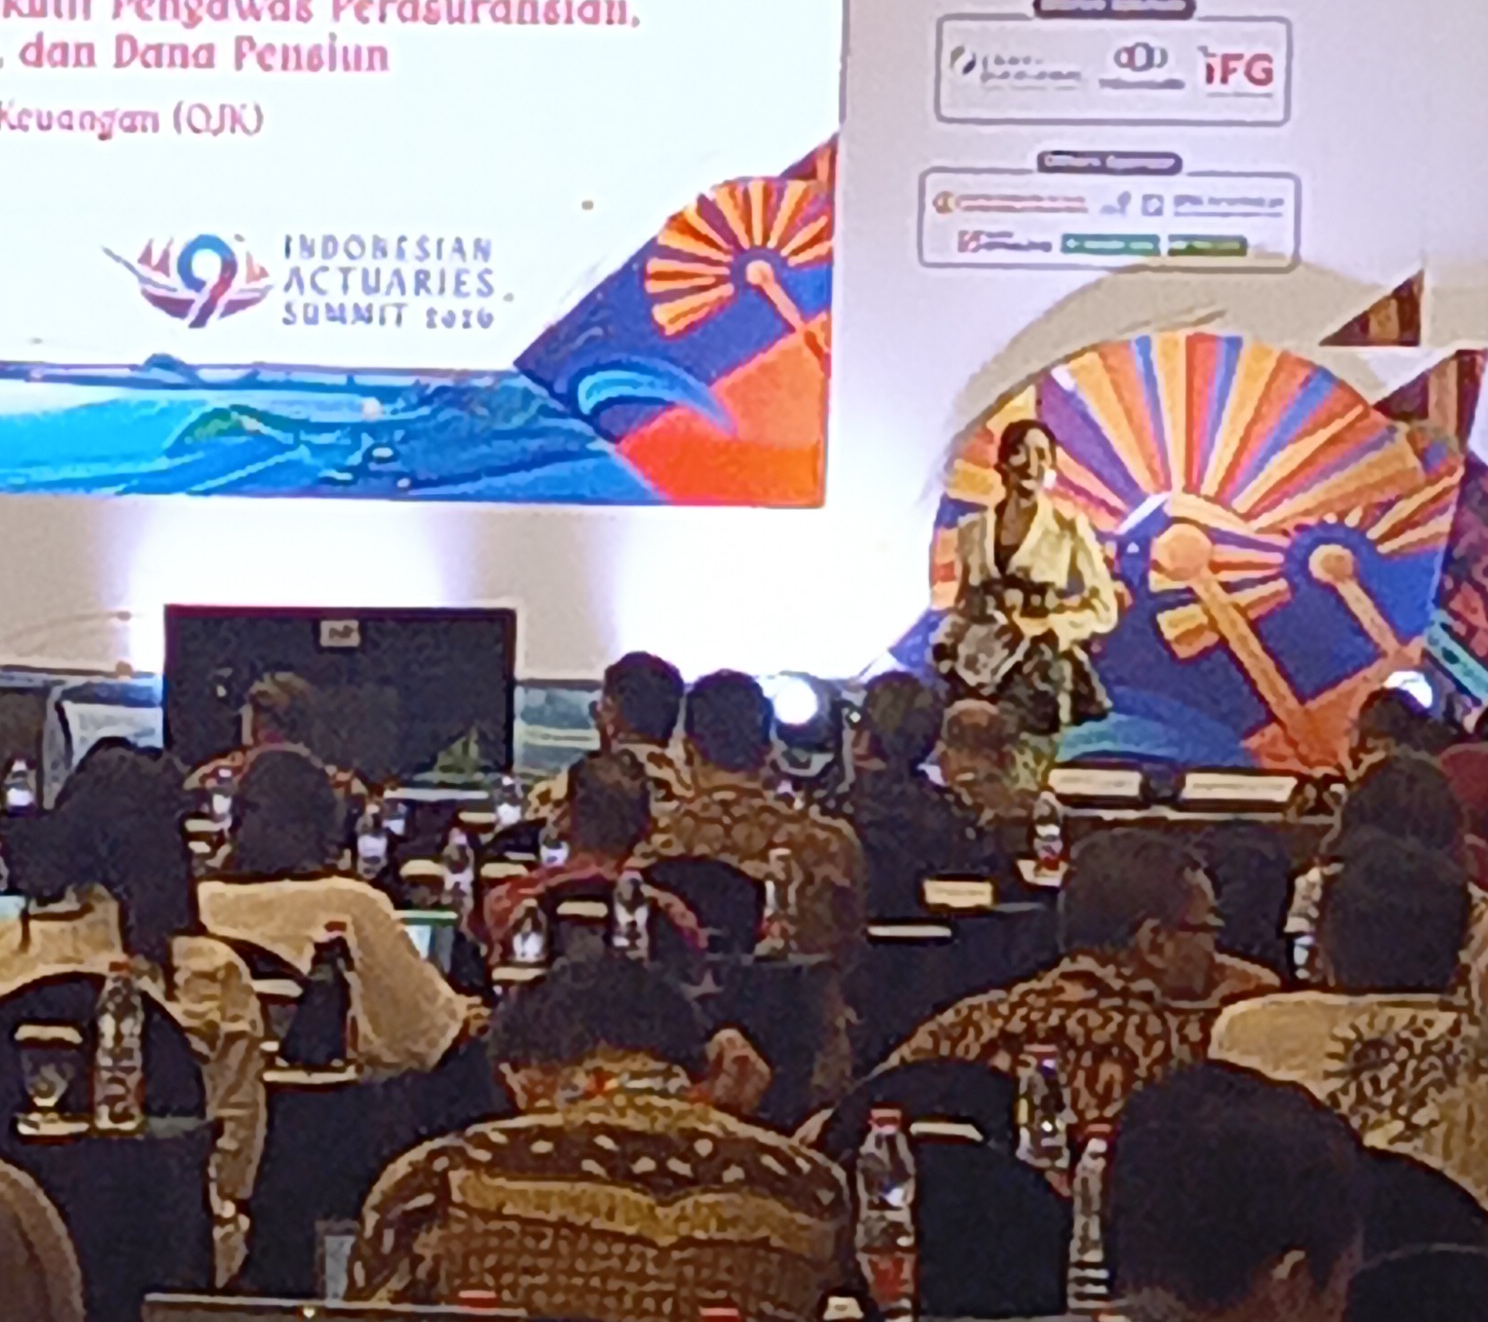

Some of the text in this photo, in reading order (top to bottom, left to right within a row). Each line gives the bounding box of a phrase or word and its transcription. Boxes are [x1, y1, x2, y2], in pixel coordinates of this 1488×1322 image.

[18, 31, 96, 68] dan
[113, 32, 216, 69] Dana
[234, 32, 390, 72] Pensiun
[283, 233, 492, 263] INDONESIAN
[282, 265, 495, 299] ACTUARIES
[281, 300, 409, 328] SUMMIT
